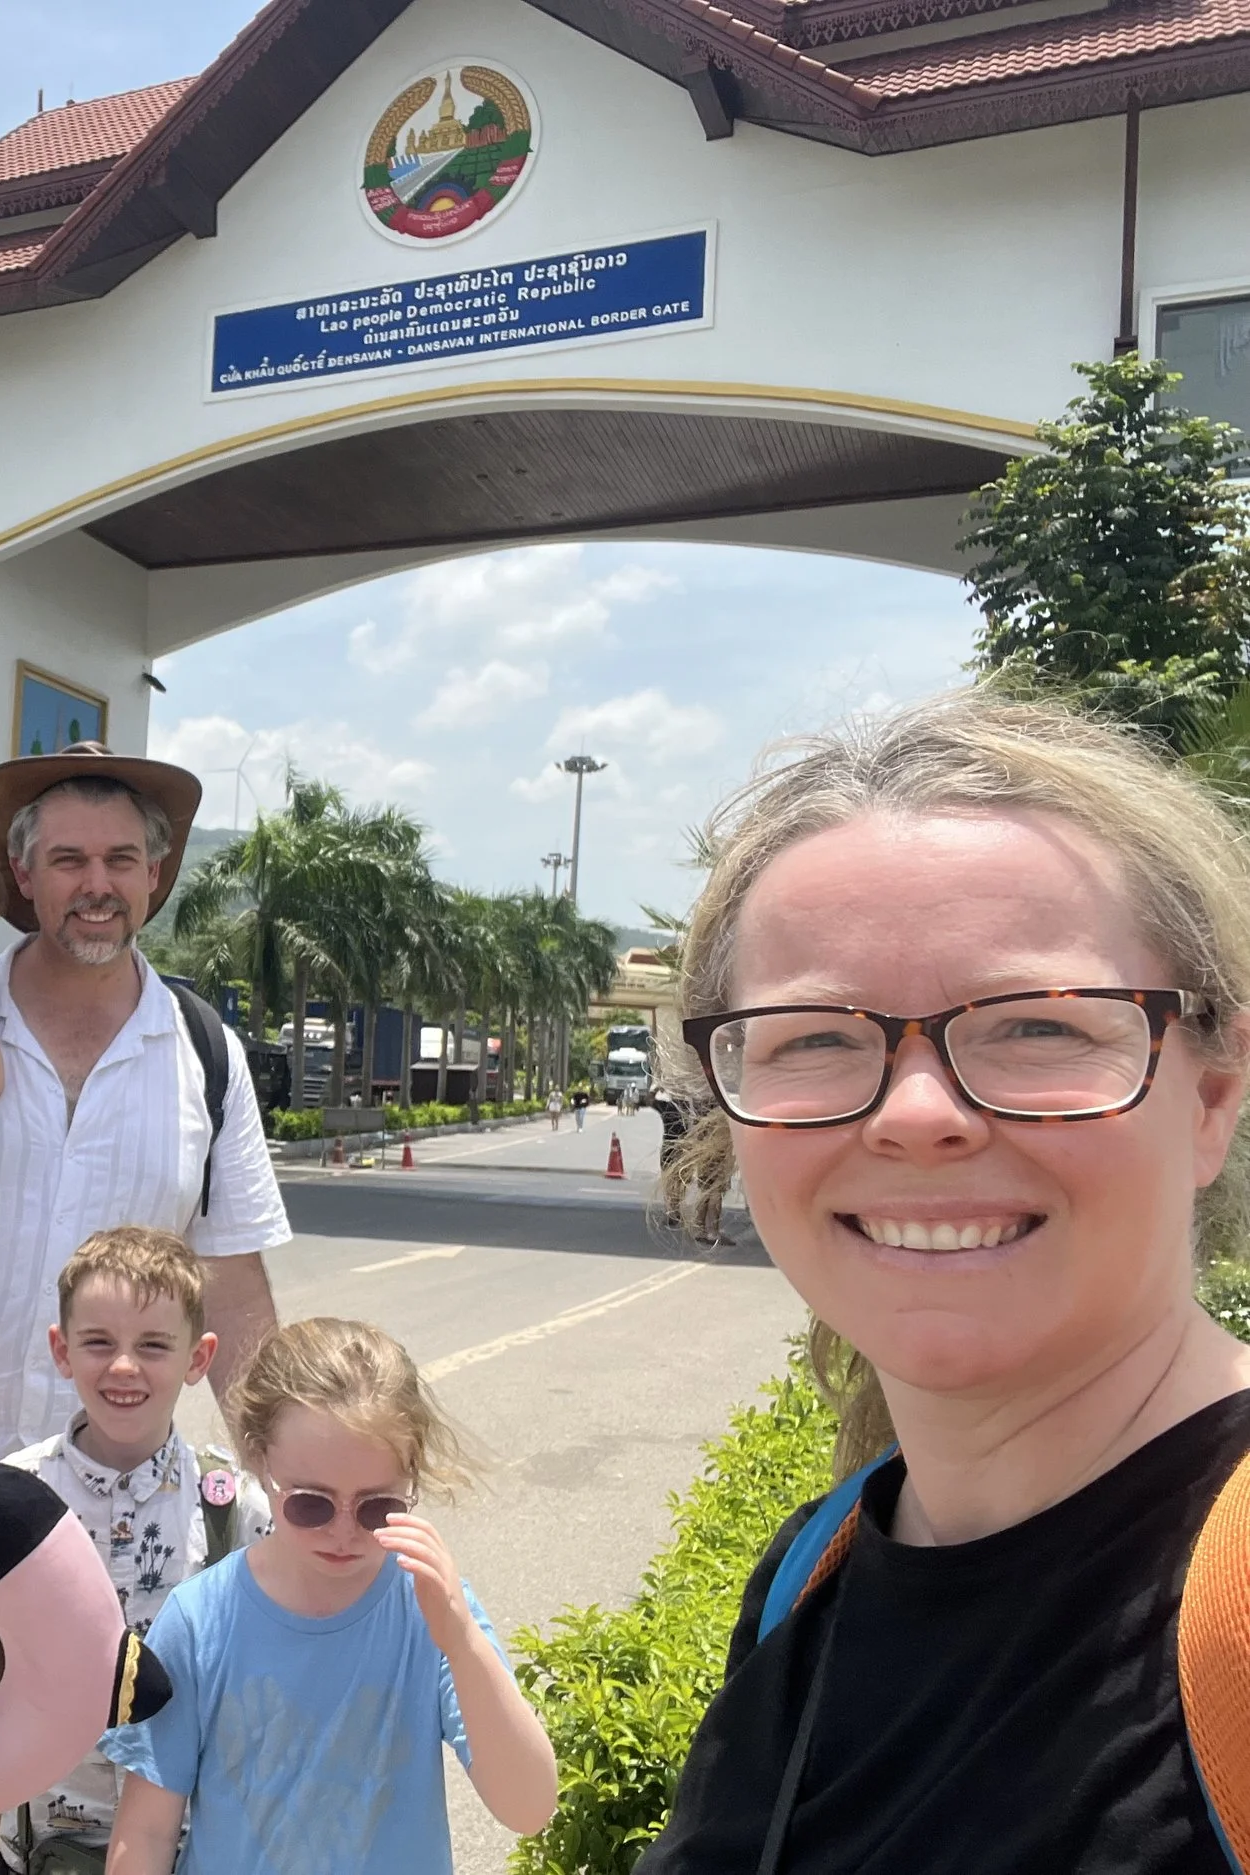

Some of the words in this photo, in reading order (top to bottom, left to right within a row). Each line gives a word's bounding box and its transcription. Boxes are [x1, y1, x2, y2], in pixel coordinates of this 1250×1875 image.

[320, 318, 349, 333] Lao
[352, 309, 403, 331] people
[406, 290, 507, 319] Democratic
[517, 277, 597, 302] Republic
[407, 335, 475, 356] DANSAVAN
[479, 319, 586, 344] INTERNATIONAL
[591, 308, 647, 327] BORDER
[652, 300, 691, 317] GATE
